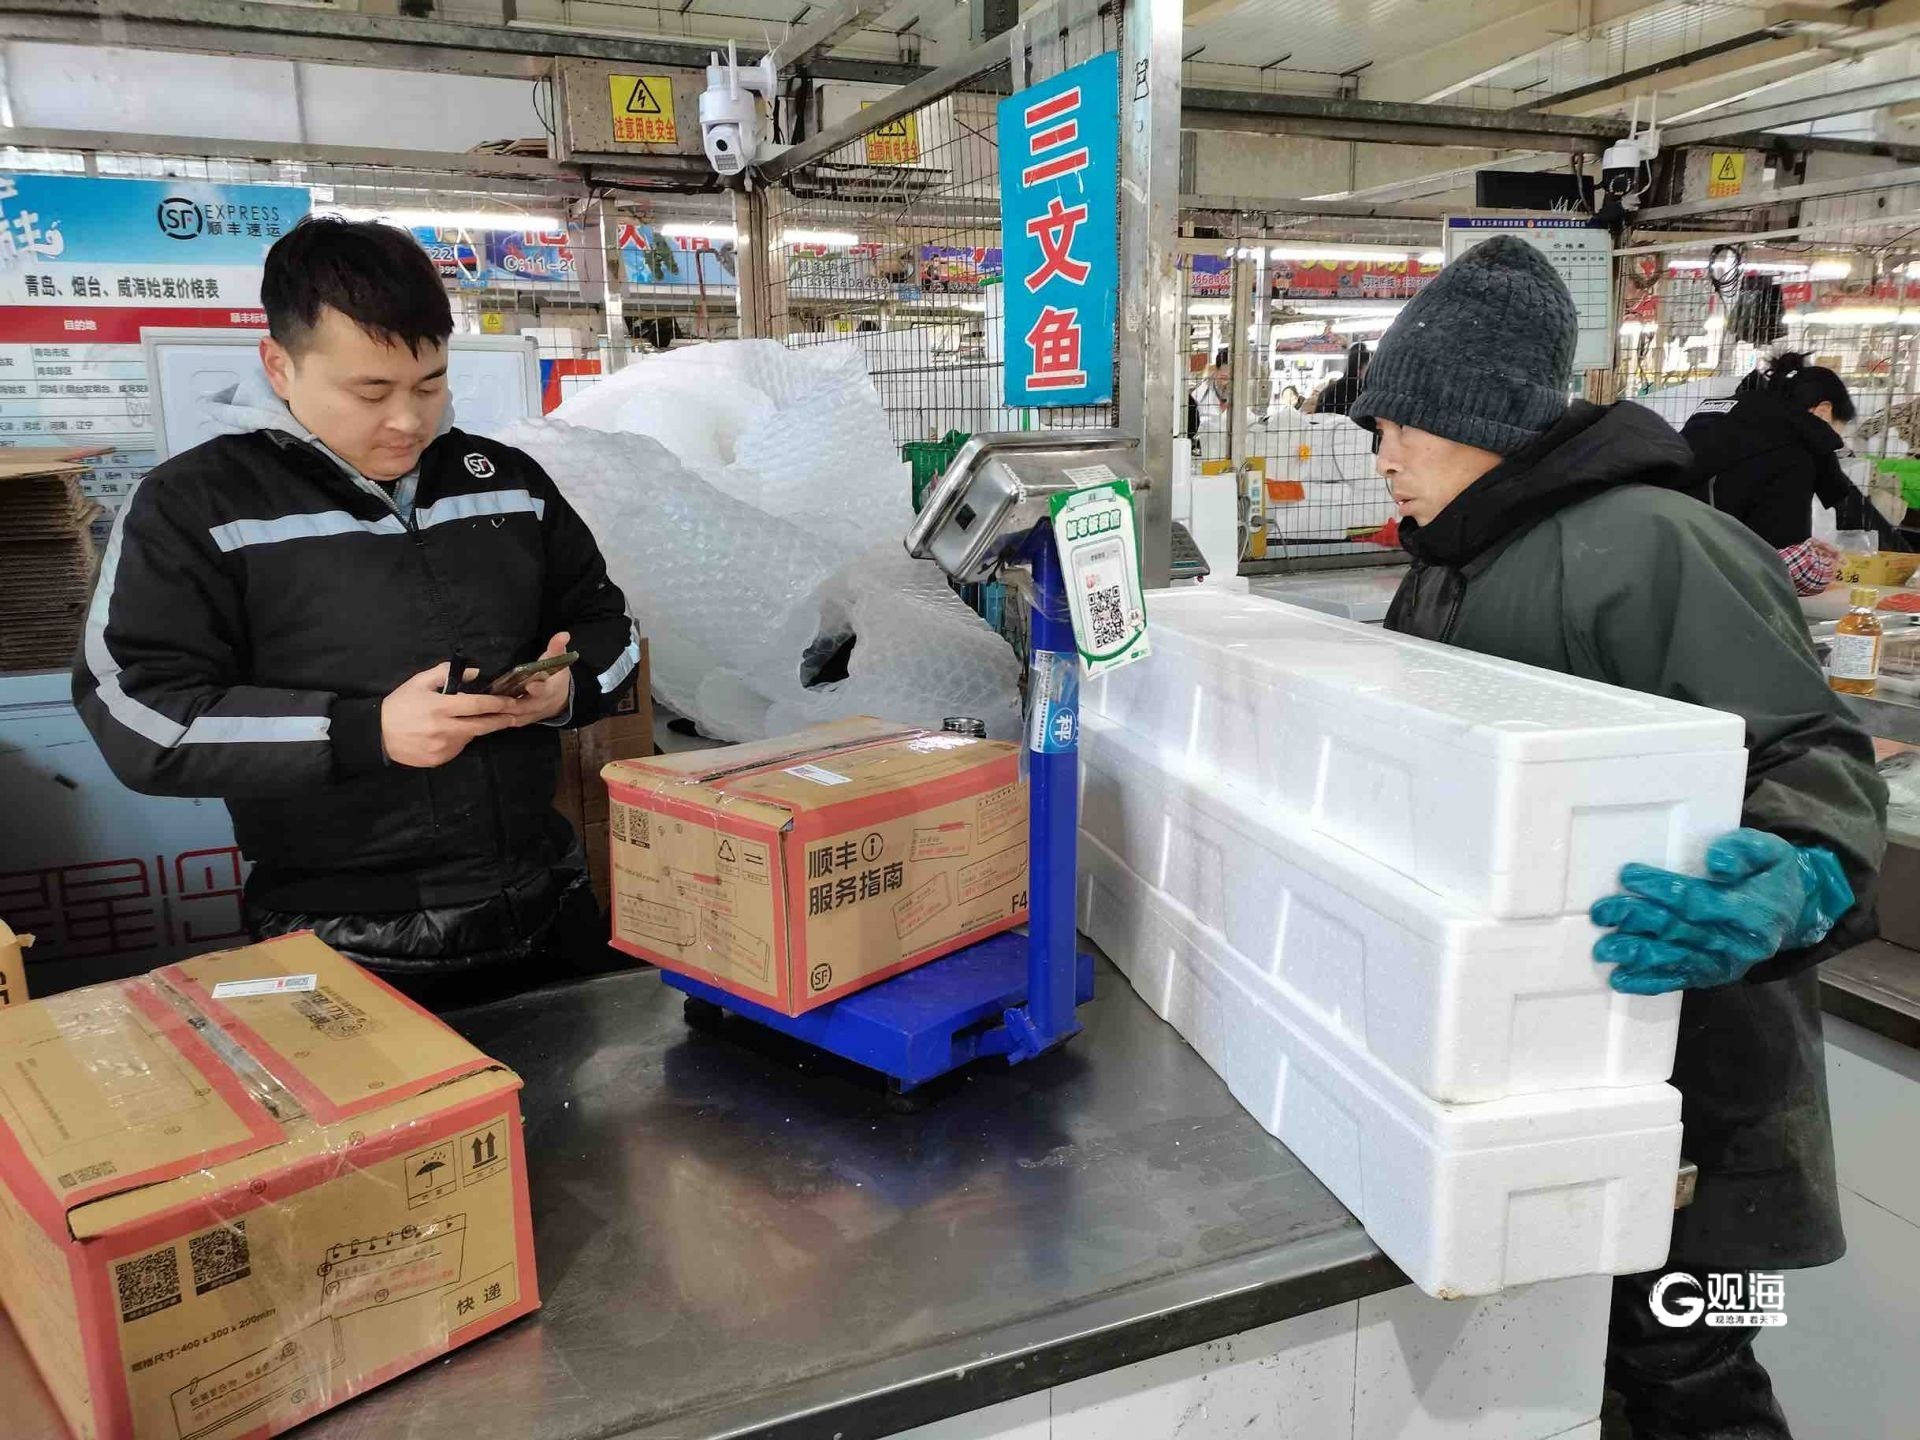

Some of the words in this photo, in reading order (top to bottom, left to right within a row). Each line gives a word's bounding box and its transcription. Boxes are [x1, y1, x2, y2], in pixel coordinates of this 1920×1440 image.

[614, 116, 676, 140] 注意用电安全
[205, 204, 280, 222] EXPRESS
[207, 221, 282, 237] 顺丰速运
[1023, 86, 1091, 391] 三文鱼
[25, 274, 220, 300] 青岛、烟台、威海始发价格表
[808, 840, 858, 881] 顺丰
[808, 861, 904, 917] 服务指南
[456, 1281, 502, 1316] 快递
